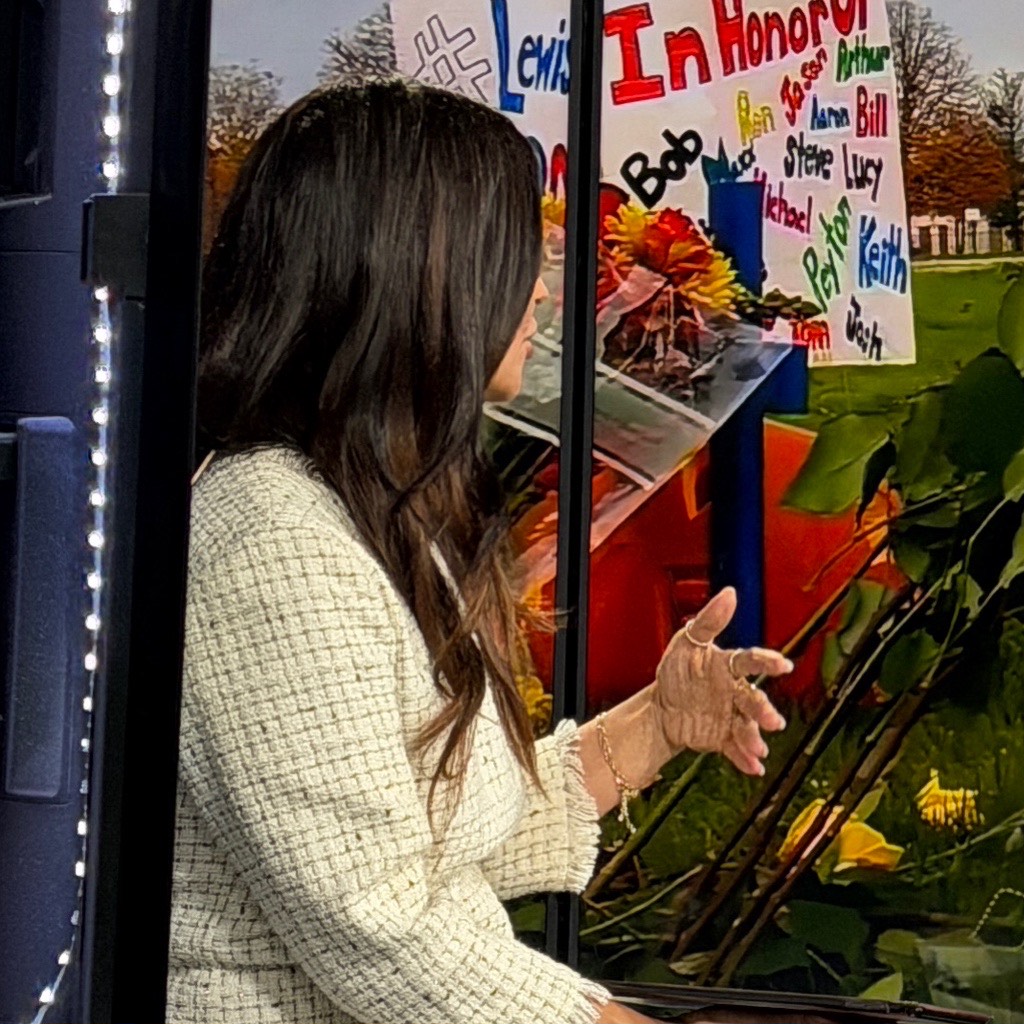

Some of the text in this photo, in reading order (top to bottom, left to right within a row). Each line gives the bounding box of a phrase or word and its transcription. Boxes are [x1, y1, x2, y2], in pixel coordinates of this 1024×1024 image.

[603, 2, 712, 105] In
[712, 0, 828, 77] Honor
[836, 33, 890, 82] Arthur
[856, 85, 888, 137] Bill
[620, 128, 703, 210] Bob
[784, 131, 833, 180] Steve
[842, 143, 883, 203] Lucy
[859, 214, 907, 294] Keith
